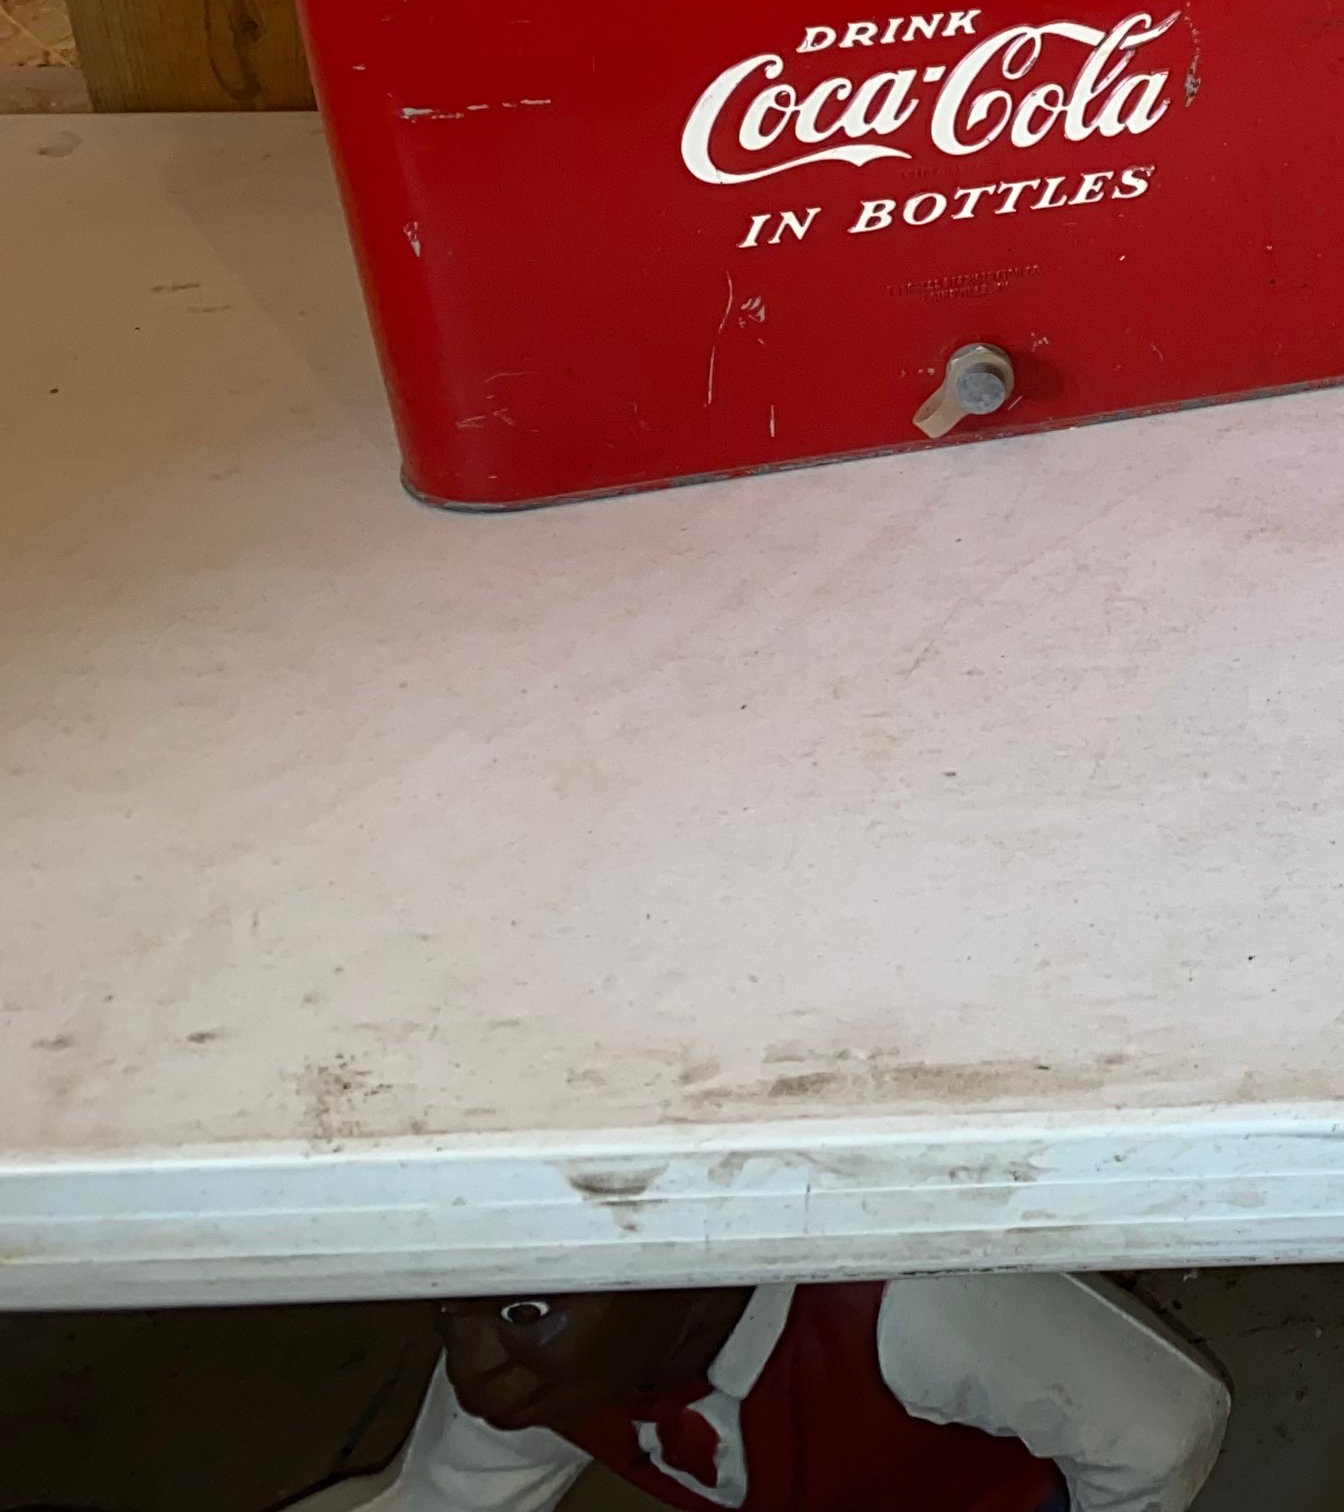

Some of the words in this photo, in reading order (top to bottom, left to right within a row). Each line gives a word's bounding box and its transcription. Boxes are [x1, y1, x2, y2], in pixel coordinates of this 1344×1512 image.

[796, 9, 982, 53] DRINK
[681, 11, 1182, 185] Coca-Cola
[737, 208, 821, 248] IN
[848, 165, 1156, 234] BOTTLES
